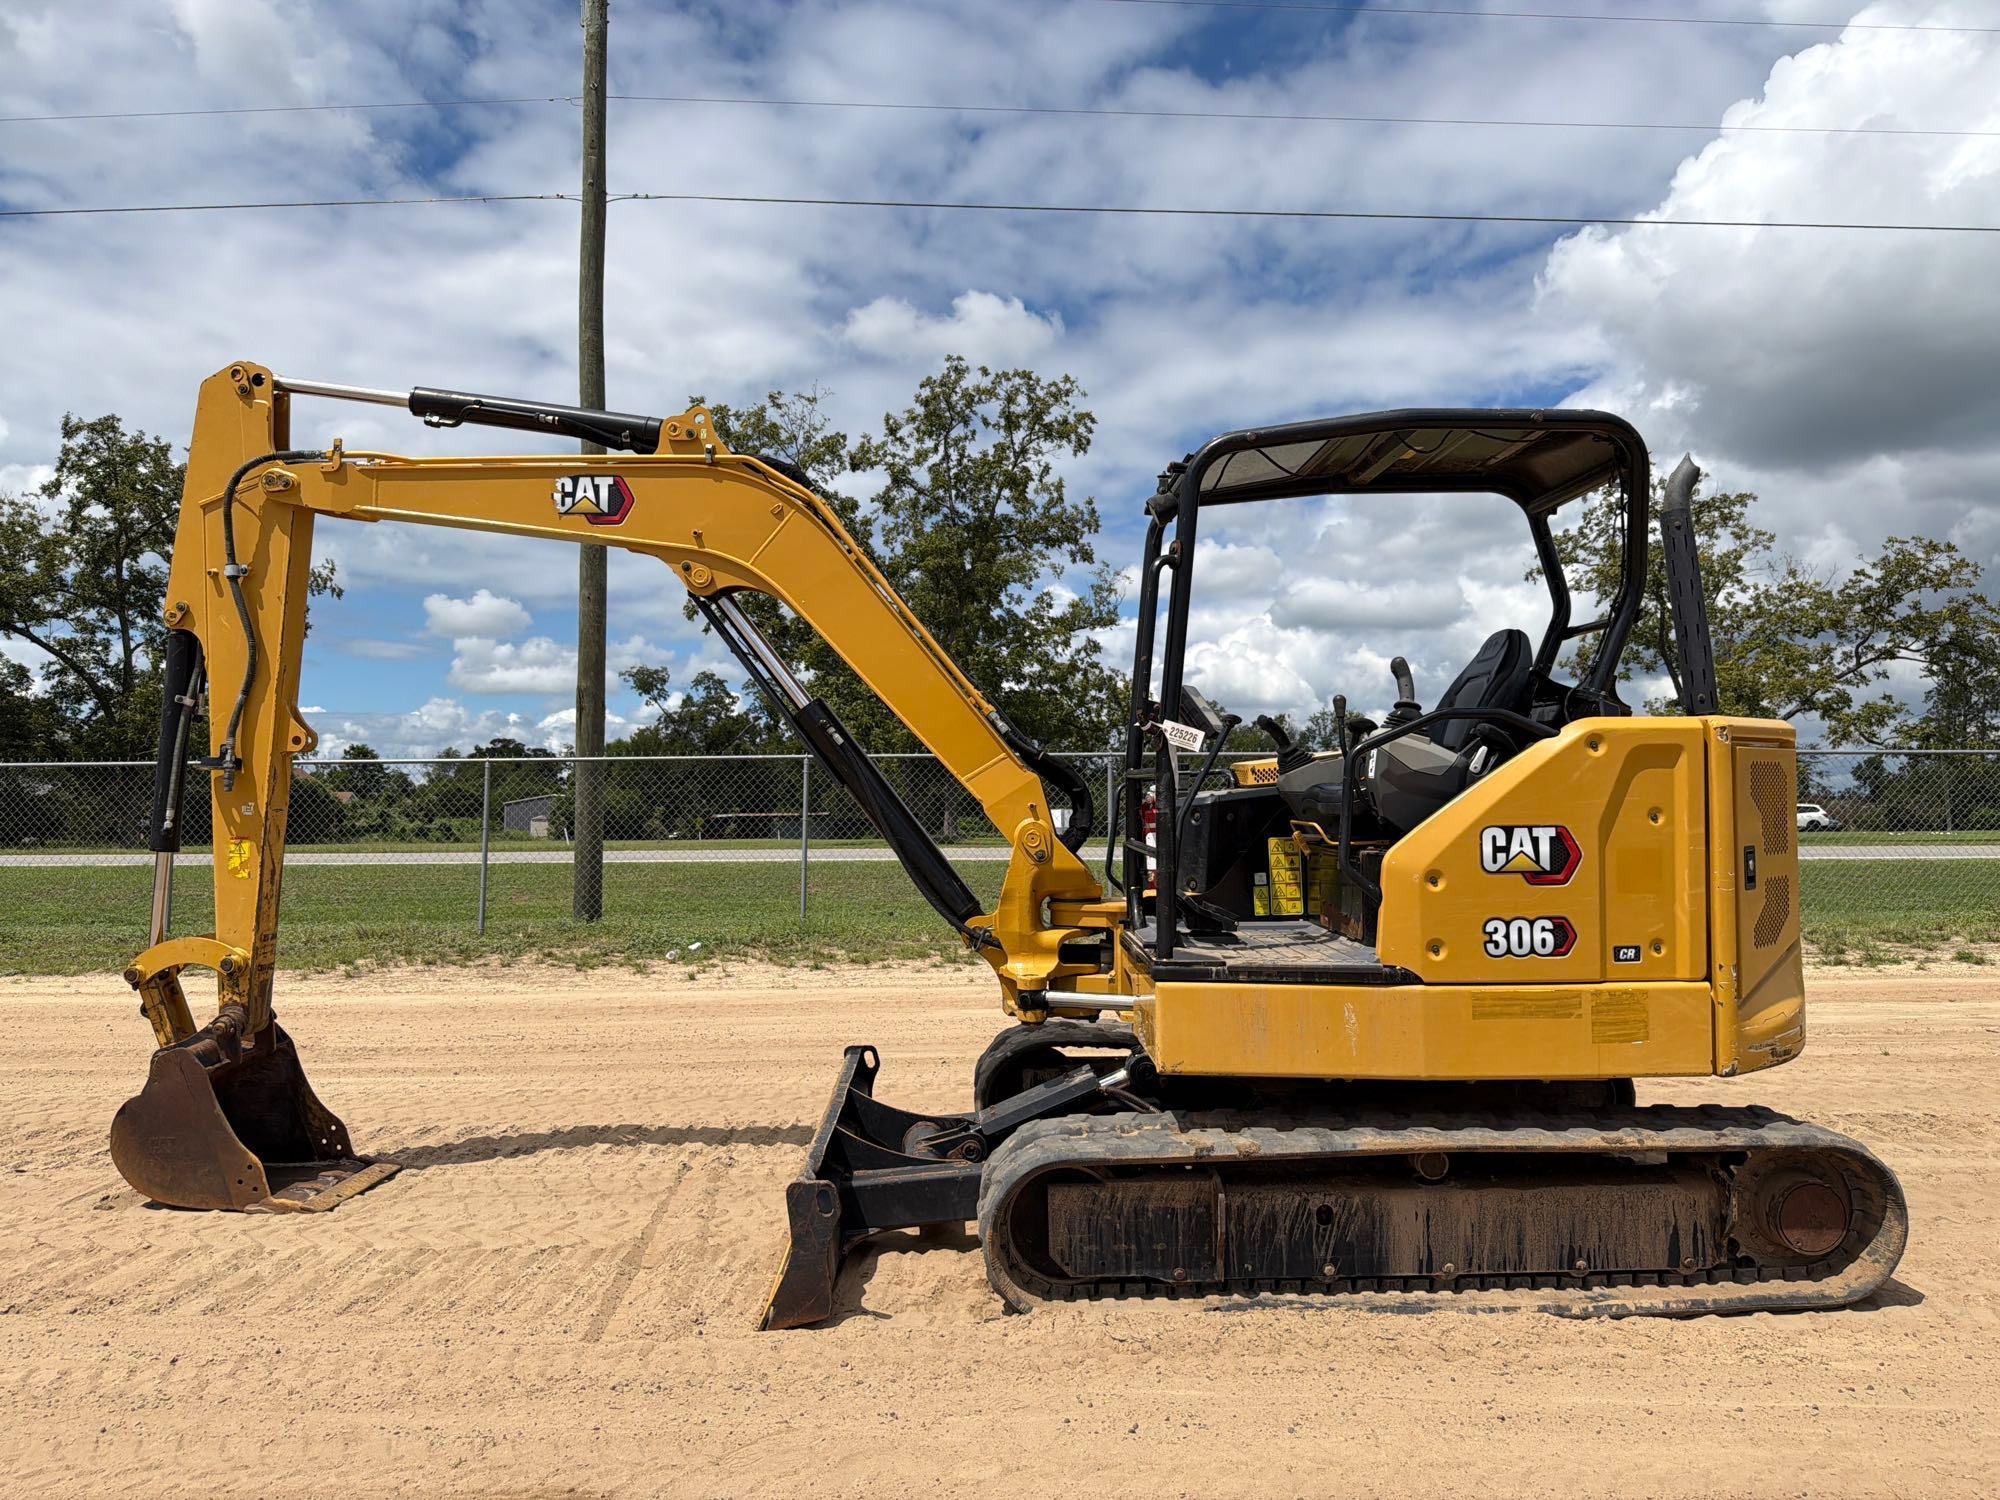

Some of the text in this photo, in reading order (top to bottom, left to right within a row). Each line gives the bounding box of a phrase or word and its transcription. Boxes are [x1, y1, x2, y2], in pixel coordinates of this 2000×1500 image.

[553, 477, 613, 513] CAT
[1169, 727, 1198, 743] 225226
[1482, 827, 1556, 872] CAT
[1485, 919, 1555, 956] 306
[1619, 948, 1635, 960] CR
